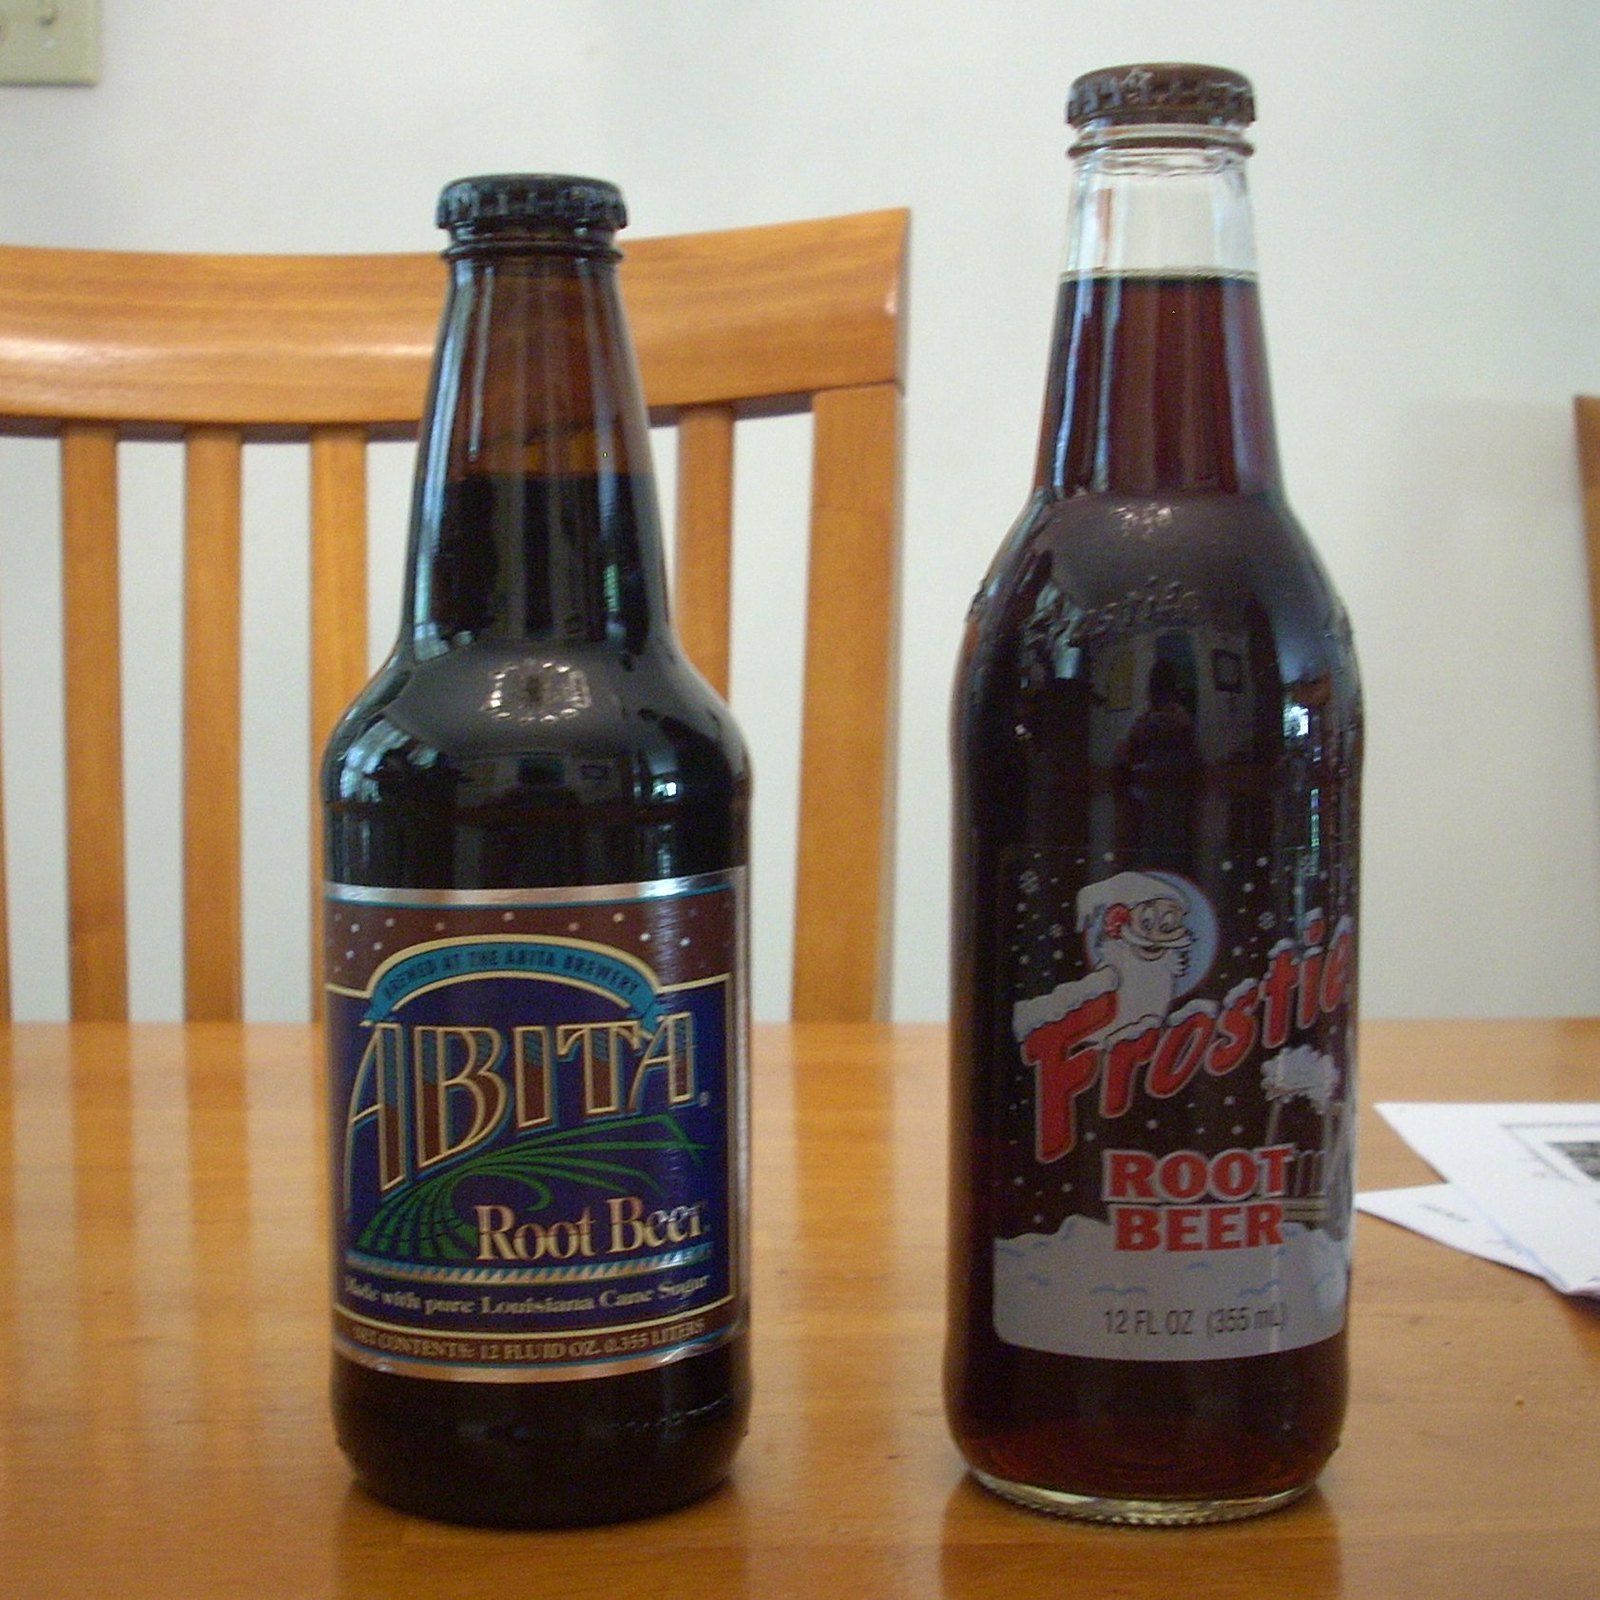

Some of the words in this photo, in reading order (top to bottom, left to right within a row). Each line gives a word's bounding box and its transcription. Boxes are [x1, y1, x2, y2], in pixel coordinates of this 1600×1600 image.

[1012, 907, 1354, 1166] Frostie
[343, 1011, 696, 1222] ABITA
[1104, 1143, 1297, 1202] ROOT
[474, 1203, 597, 1261] Root
[605, 1196, 703, 1254] Beer
[1110, 1203, 1286, 1253] BEER
[424, 1298, 474, 1317] pure
[480, 1295, 595, 1315] Louisiana
[600, 1287, 656, 1309] Cane
[1105, 1309, 1129, 1335] 12
[1134, 1309, 1161, 1336] FL
[1166, 1309, 1194, 1336] OZ
[480, 1343, 500, 1361] 12
